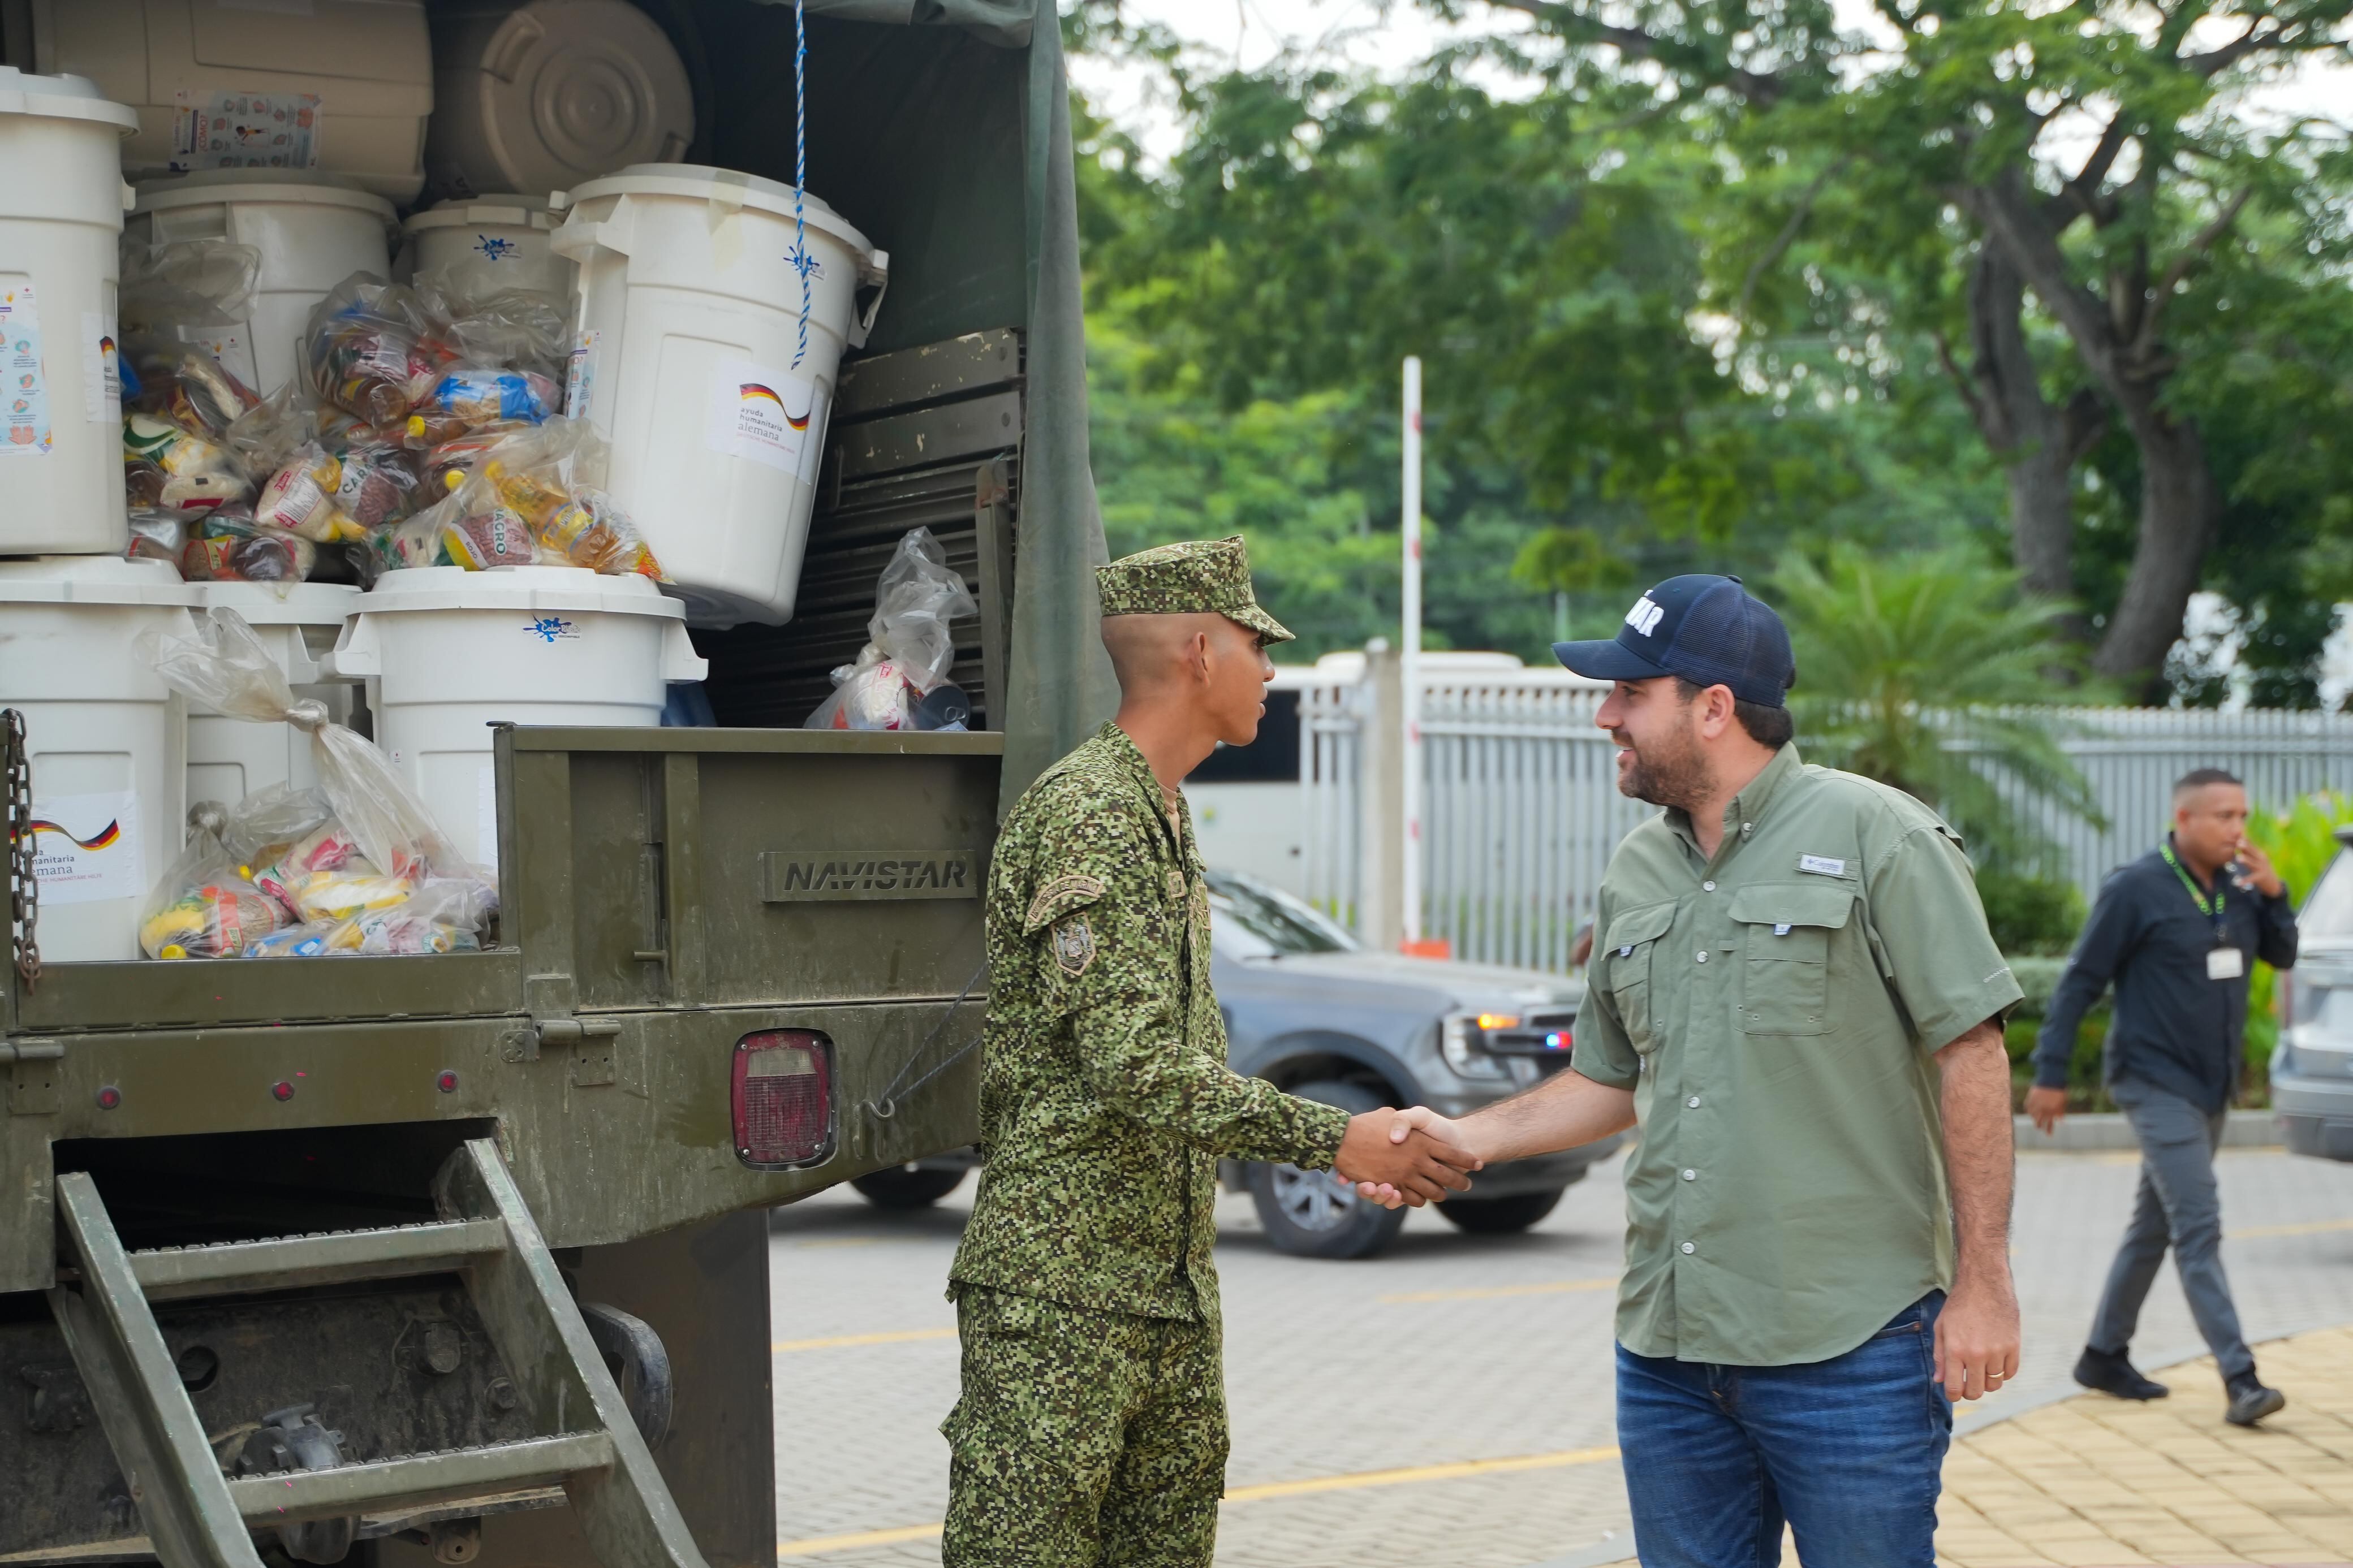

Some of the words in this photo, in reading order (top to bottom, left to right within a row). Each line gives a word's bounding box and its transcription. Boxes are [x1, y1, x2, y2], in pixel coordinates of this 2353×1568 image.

[740, 407, 763, 417] ayuda
[738, 422, 779, 441] alemana
[739, 413, 783, 432] humanitaria
[466, 541, 478, 559] ROJO
[783, 859, 968, 891] NAVISTAR
